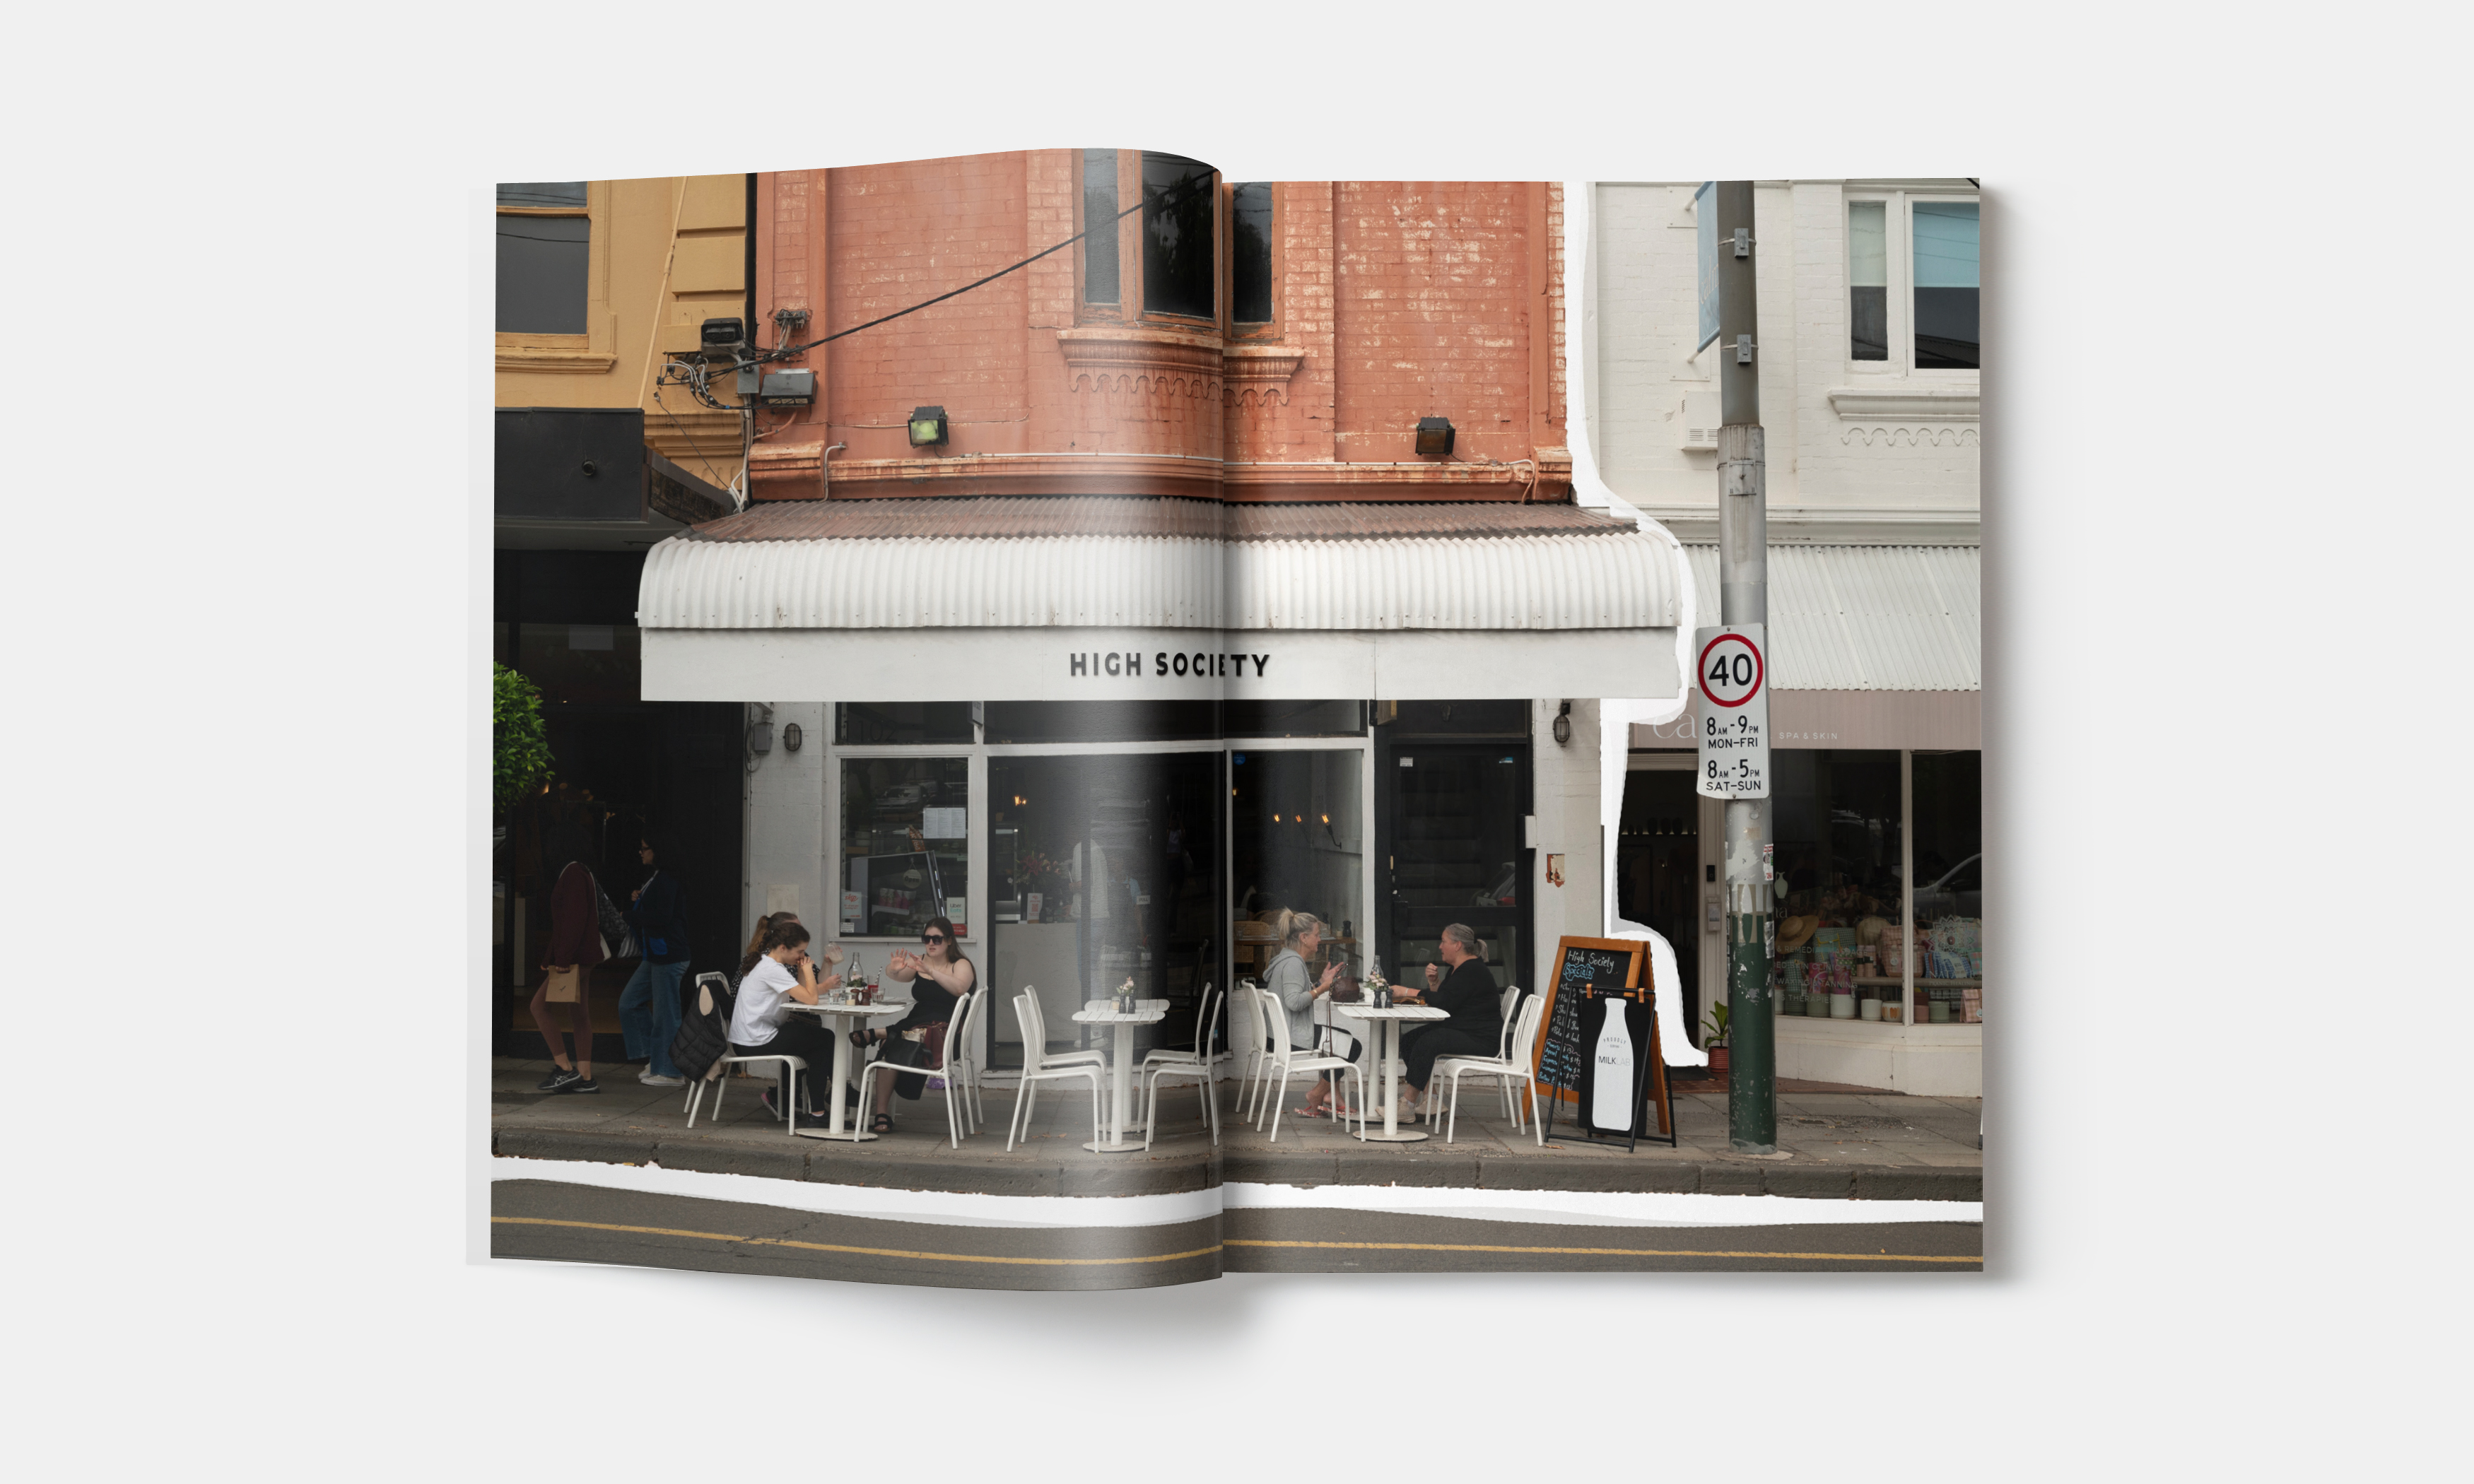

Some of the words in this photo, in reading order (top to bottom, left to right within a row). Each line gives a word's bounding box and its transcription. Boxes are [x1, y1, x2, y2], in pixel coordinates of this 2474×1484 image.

[1070, 652, 1141, 676] HIGH
[1156, 652, 1270, 677] SOCIETY
[1708, 653, 1753, 687] 40
[1779, 731, 1800, 740] SPA
[1708, 737, 1758, 749] MON-FRI
[1706, 780, 1761, 791] SAT-SUN
[1567, 950, 1585, 965] High
[1588, 952, 1614, 974] Society
[1812, 963, 1841, 972] CLINIC
[1564, 965, 1592, 978] Specials
[1777, 977, 1810, 986] WAXING
[1821, 979, 1858, 989] TANNING
